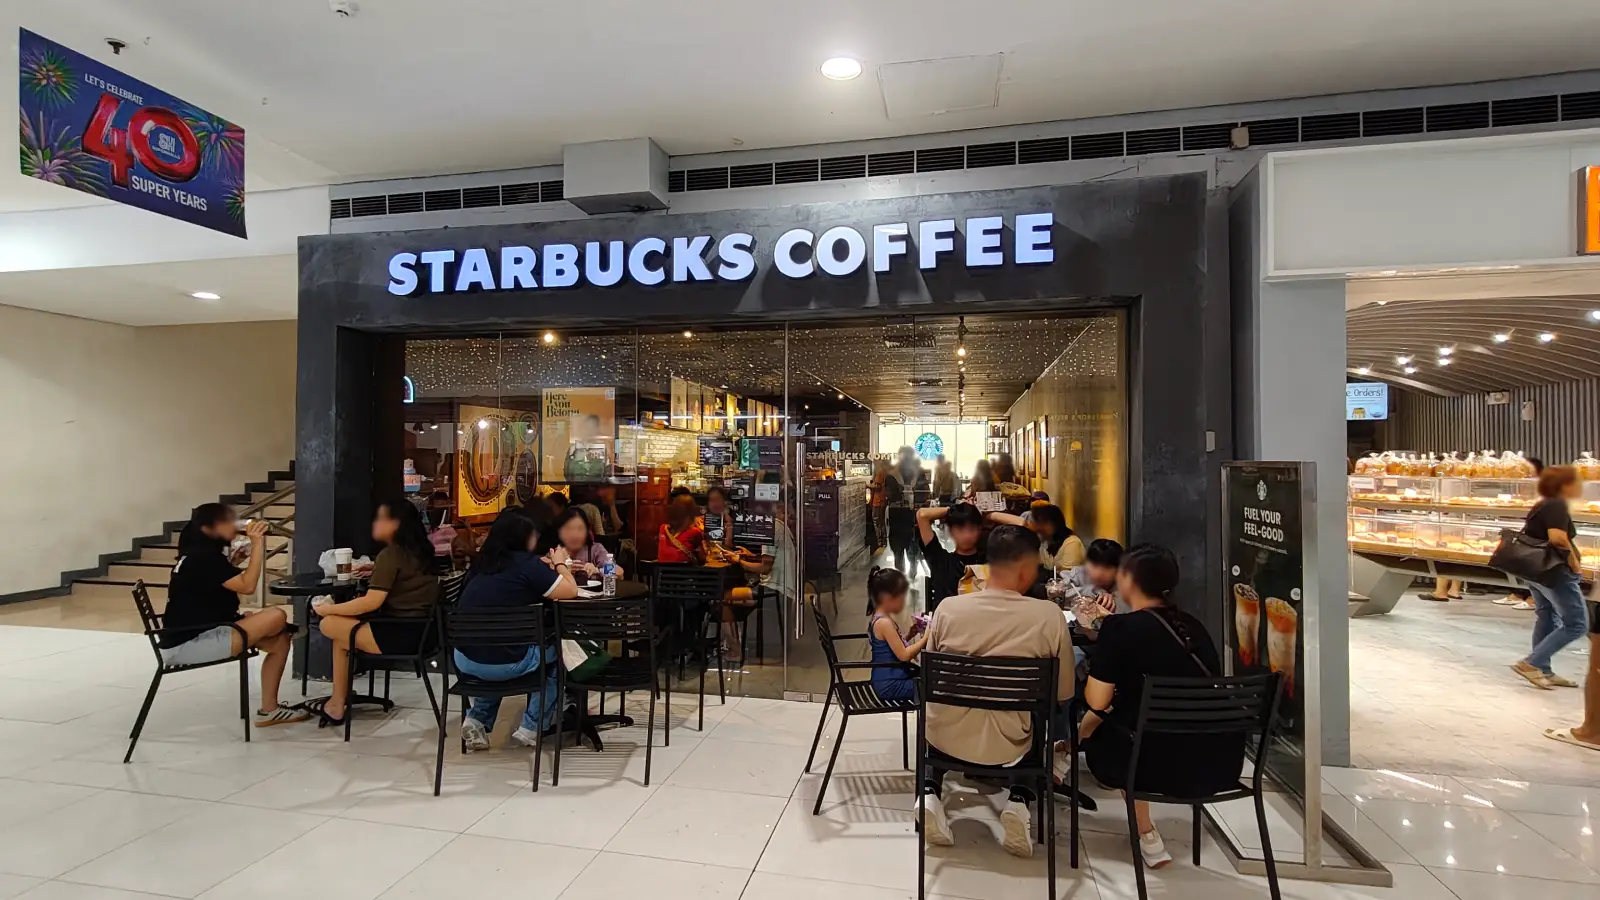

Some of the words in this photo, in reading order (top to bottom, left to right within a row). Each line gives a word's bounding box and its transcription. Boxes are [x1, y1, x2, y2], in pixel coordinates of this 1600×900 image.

[85, 73, 106, 90] LET'S
[106, 83, 144, 106] CELEBRATE
[83, 93, 201, 189] 40
[131, 175, 170, 201] SUPER
[173, 188, 208, 211] YEARS
[387, 232, 757, 297] STARBUCKS
[773, 212, 1054, 279] COFFEE
[545, 392, 568, 404] Here
[1353, 388, 1384, 397] Orders!
[806, 451, 866, 460] STARBUCKS
[1244, 506, 1260, 521] FUEL
[1260, 509, 1281, 525] YOUR
[1244, 522, 1284, 542] FEEL-GOOD
